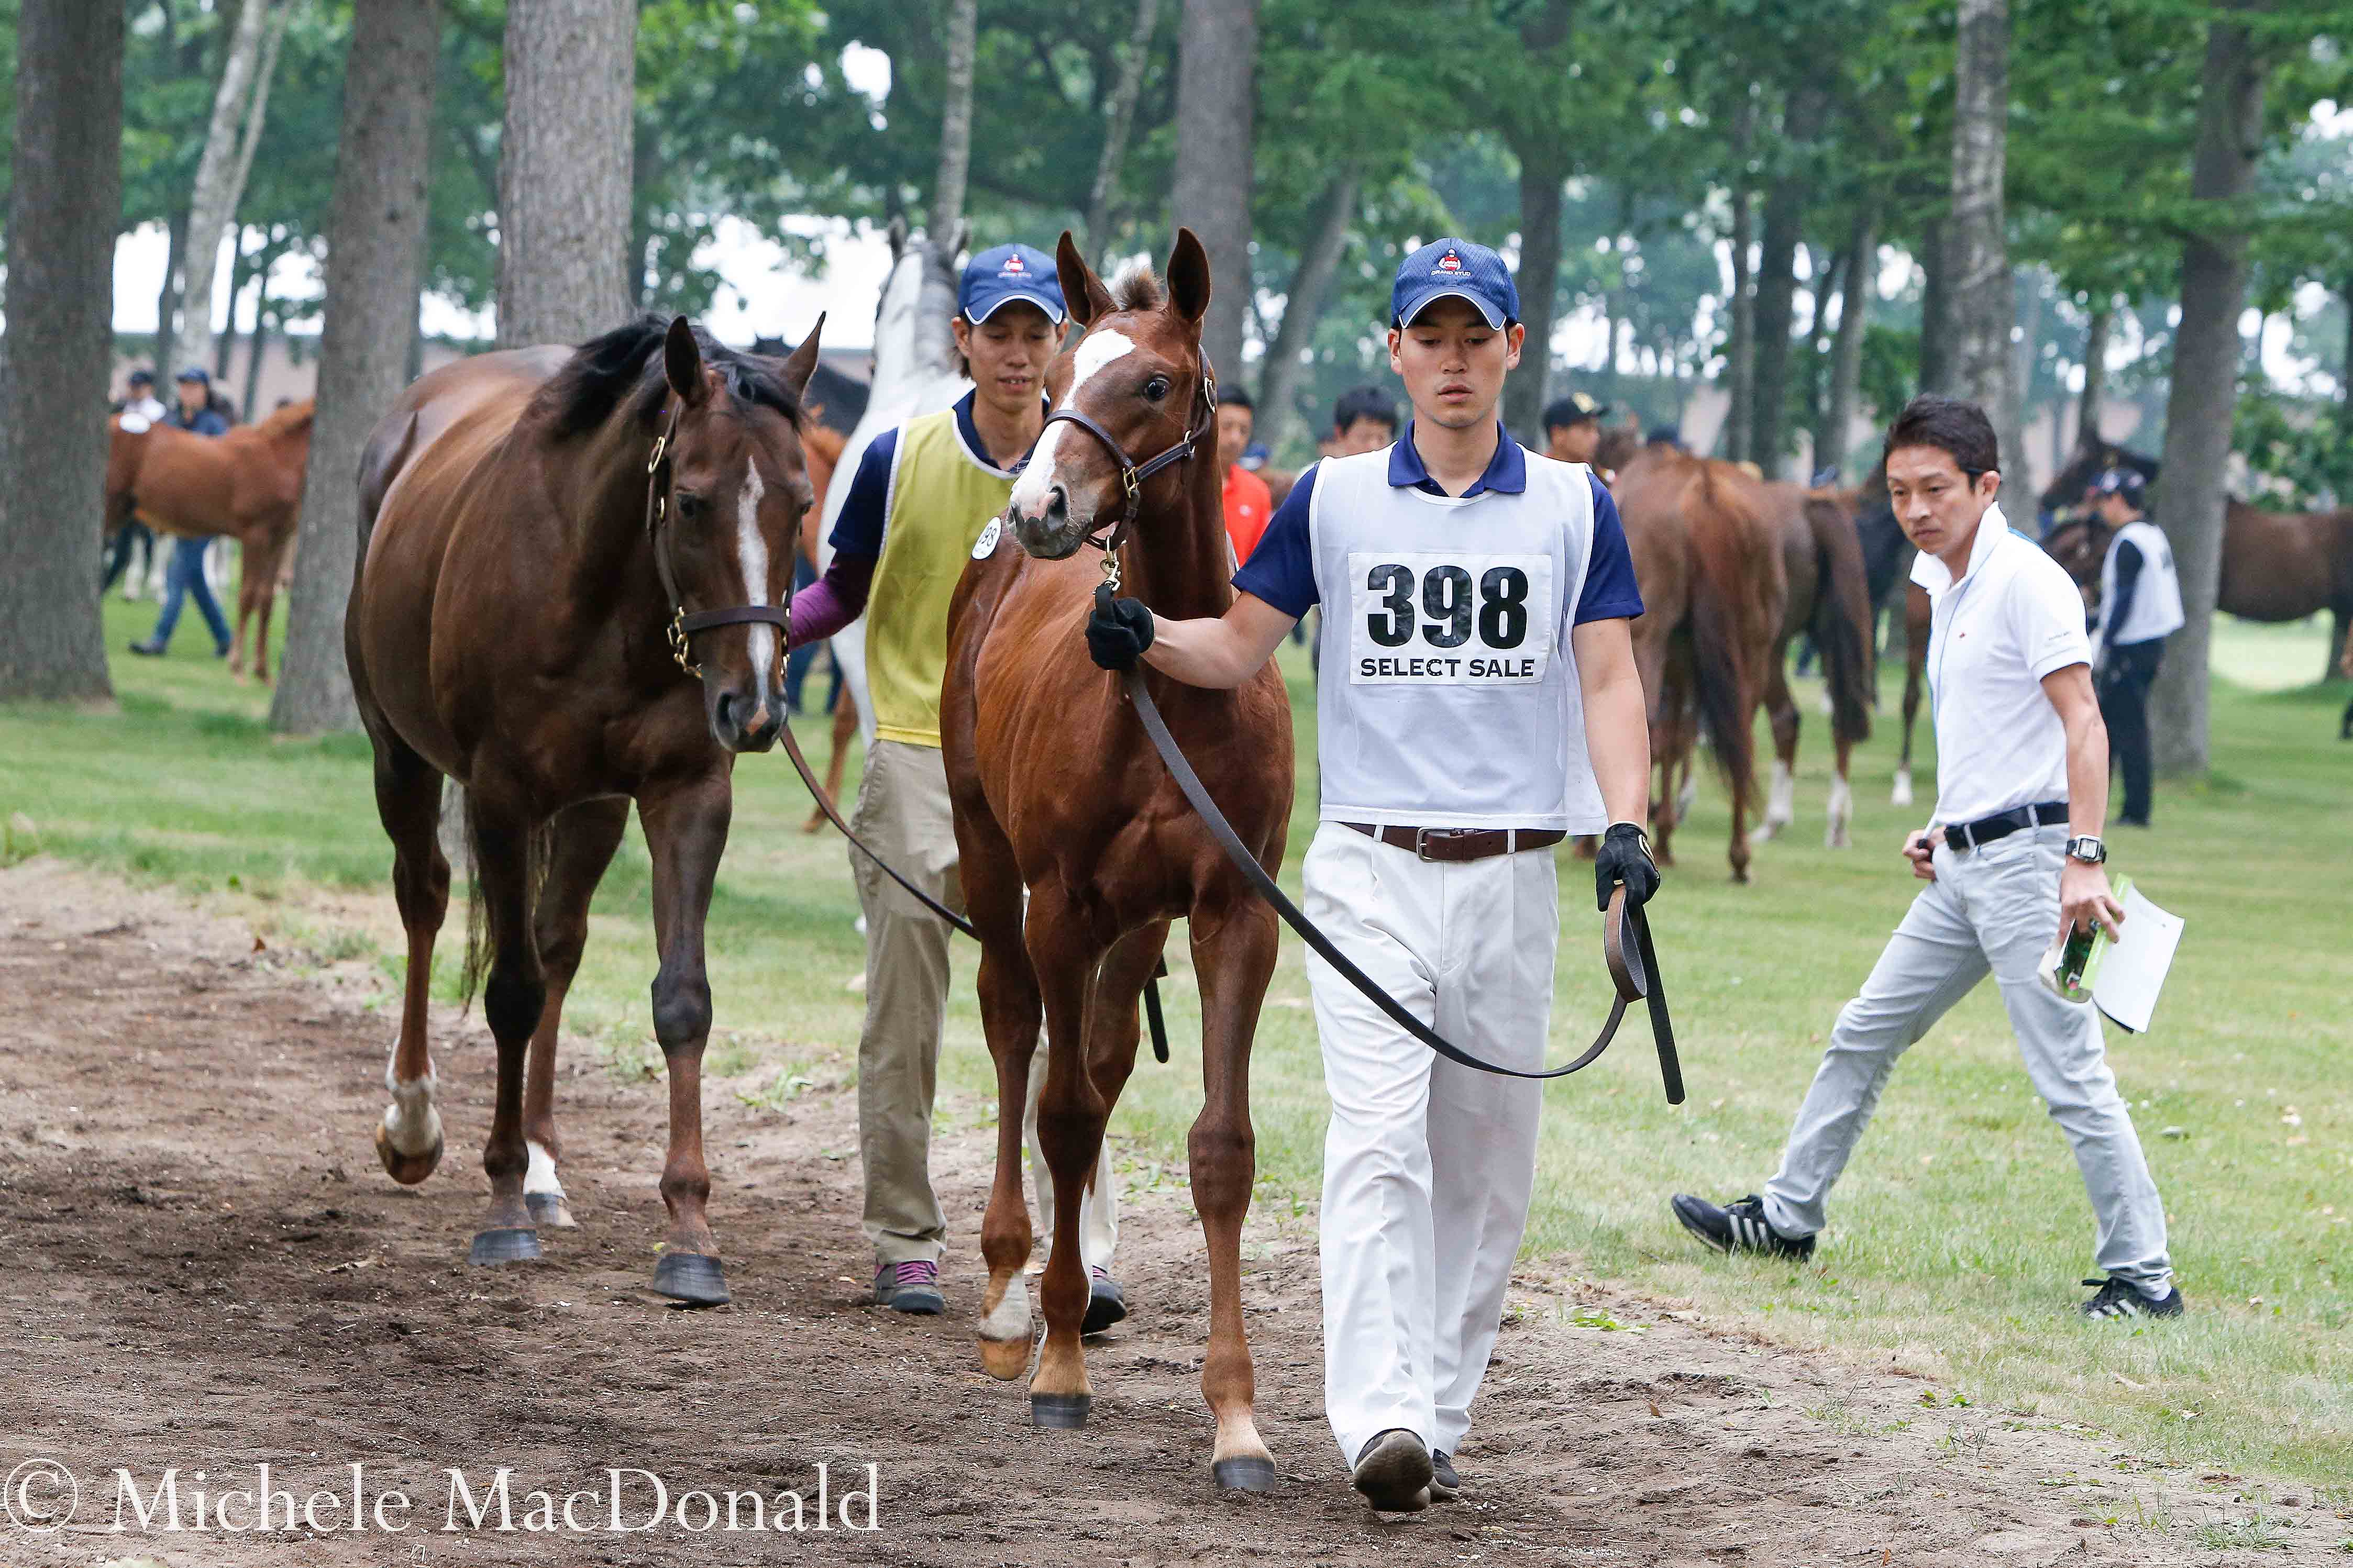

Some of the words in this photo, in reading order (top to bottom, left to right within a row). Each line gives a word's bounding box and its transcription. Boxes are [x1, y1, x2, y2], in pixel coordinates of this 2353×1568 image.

[1367, 564, 1529, 650] 398
[1361, 658, 1461, 677] SELECT
[1468, 658, 1535, 677] SALE
